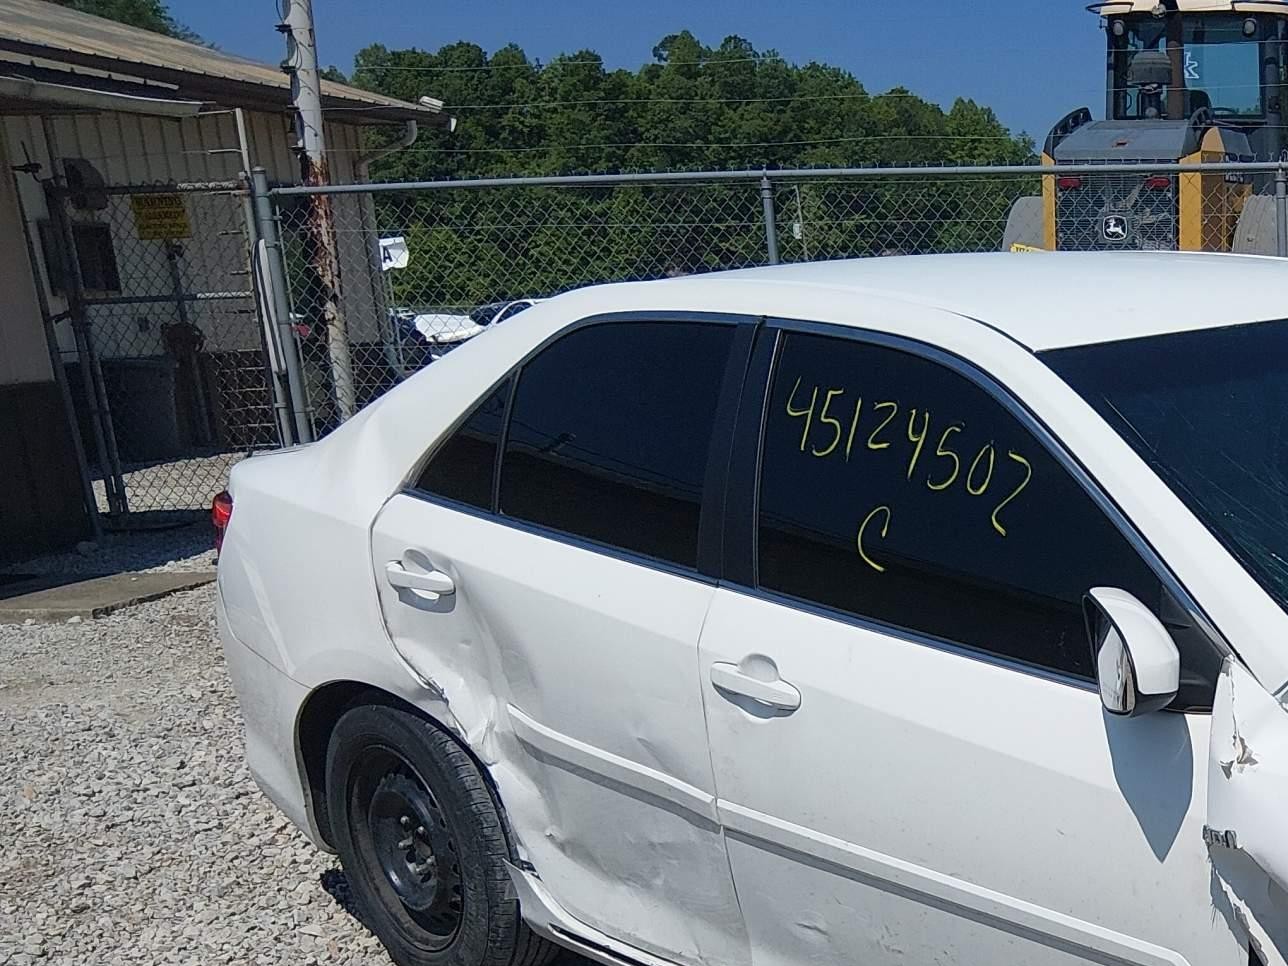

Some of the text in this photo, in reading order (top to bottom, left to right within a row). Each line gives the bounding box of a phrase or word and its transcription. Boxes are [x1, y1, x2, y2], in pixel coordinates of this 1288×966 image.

[382, 246, 393, 263] A
[786, 375, 1033, 537] 45124502
[856, 505, 891, 573] C
